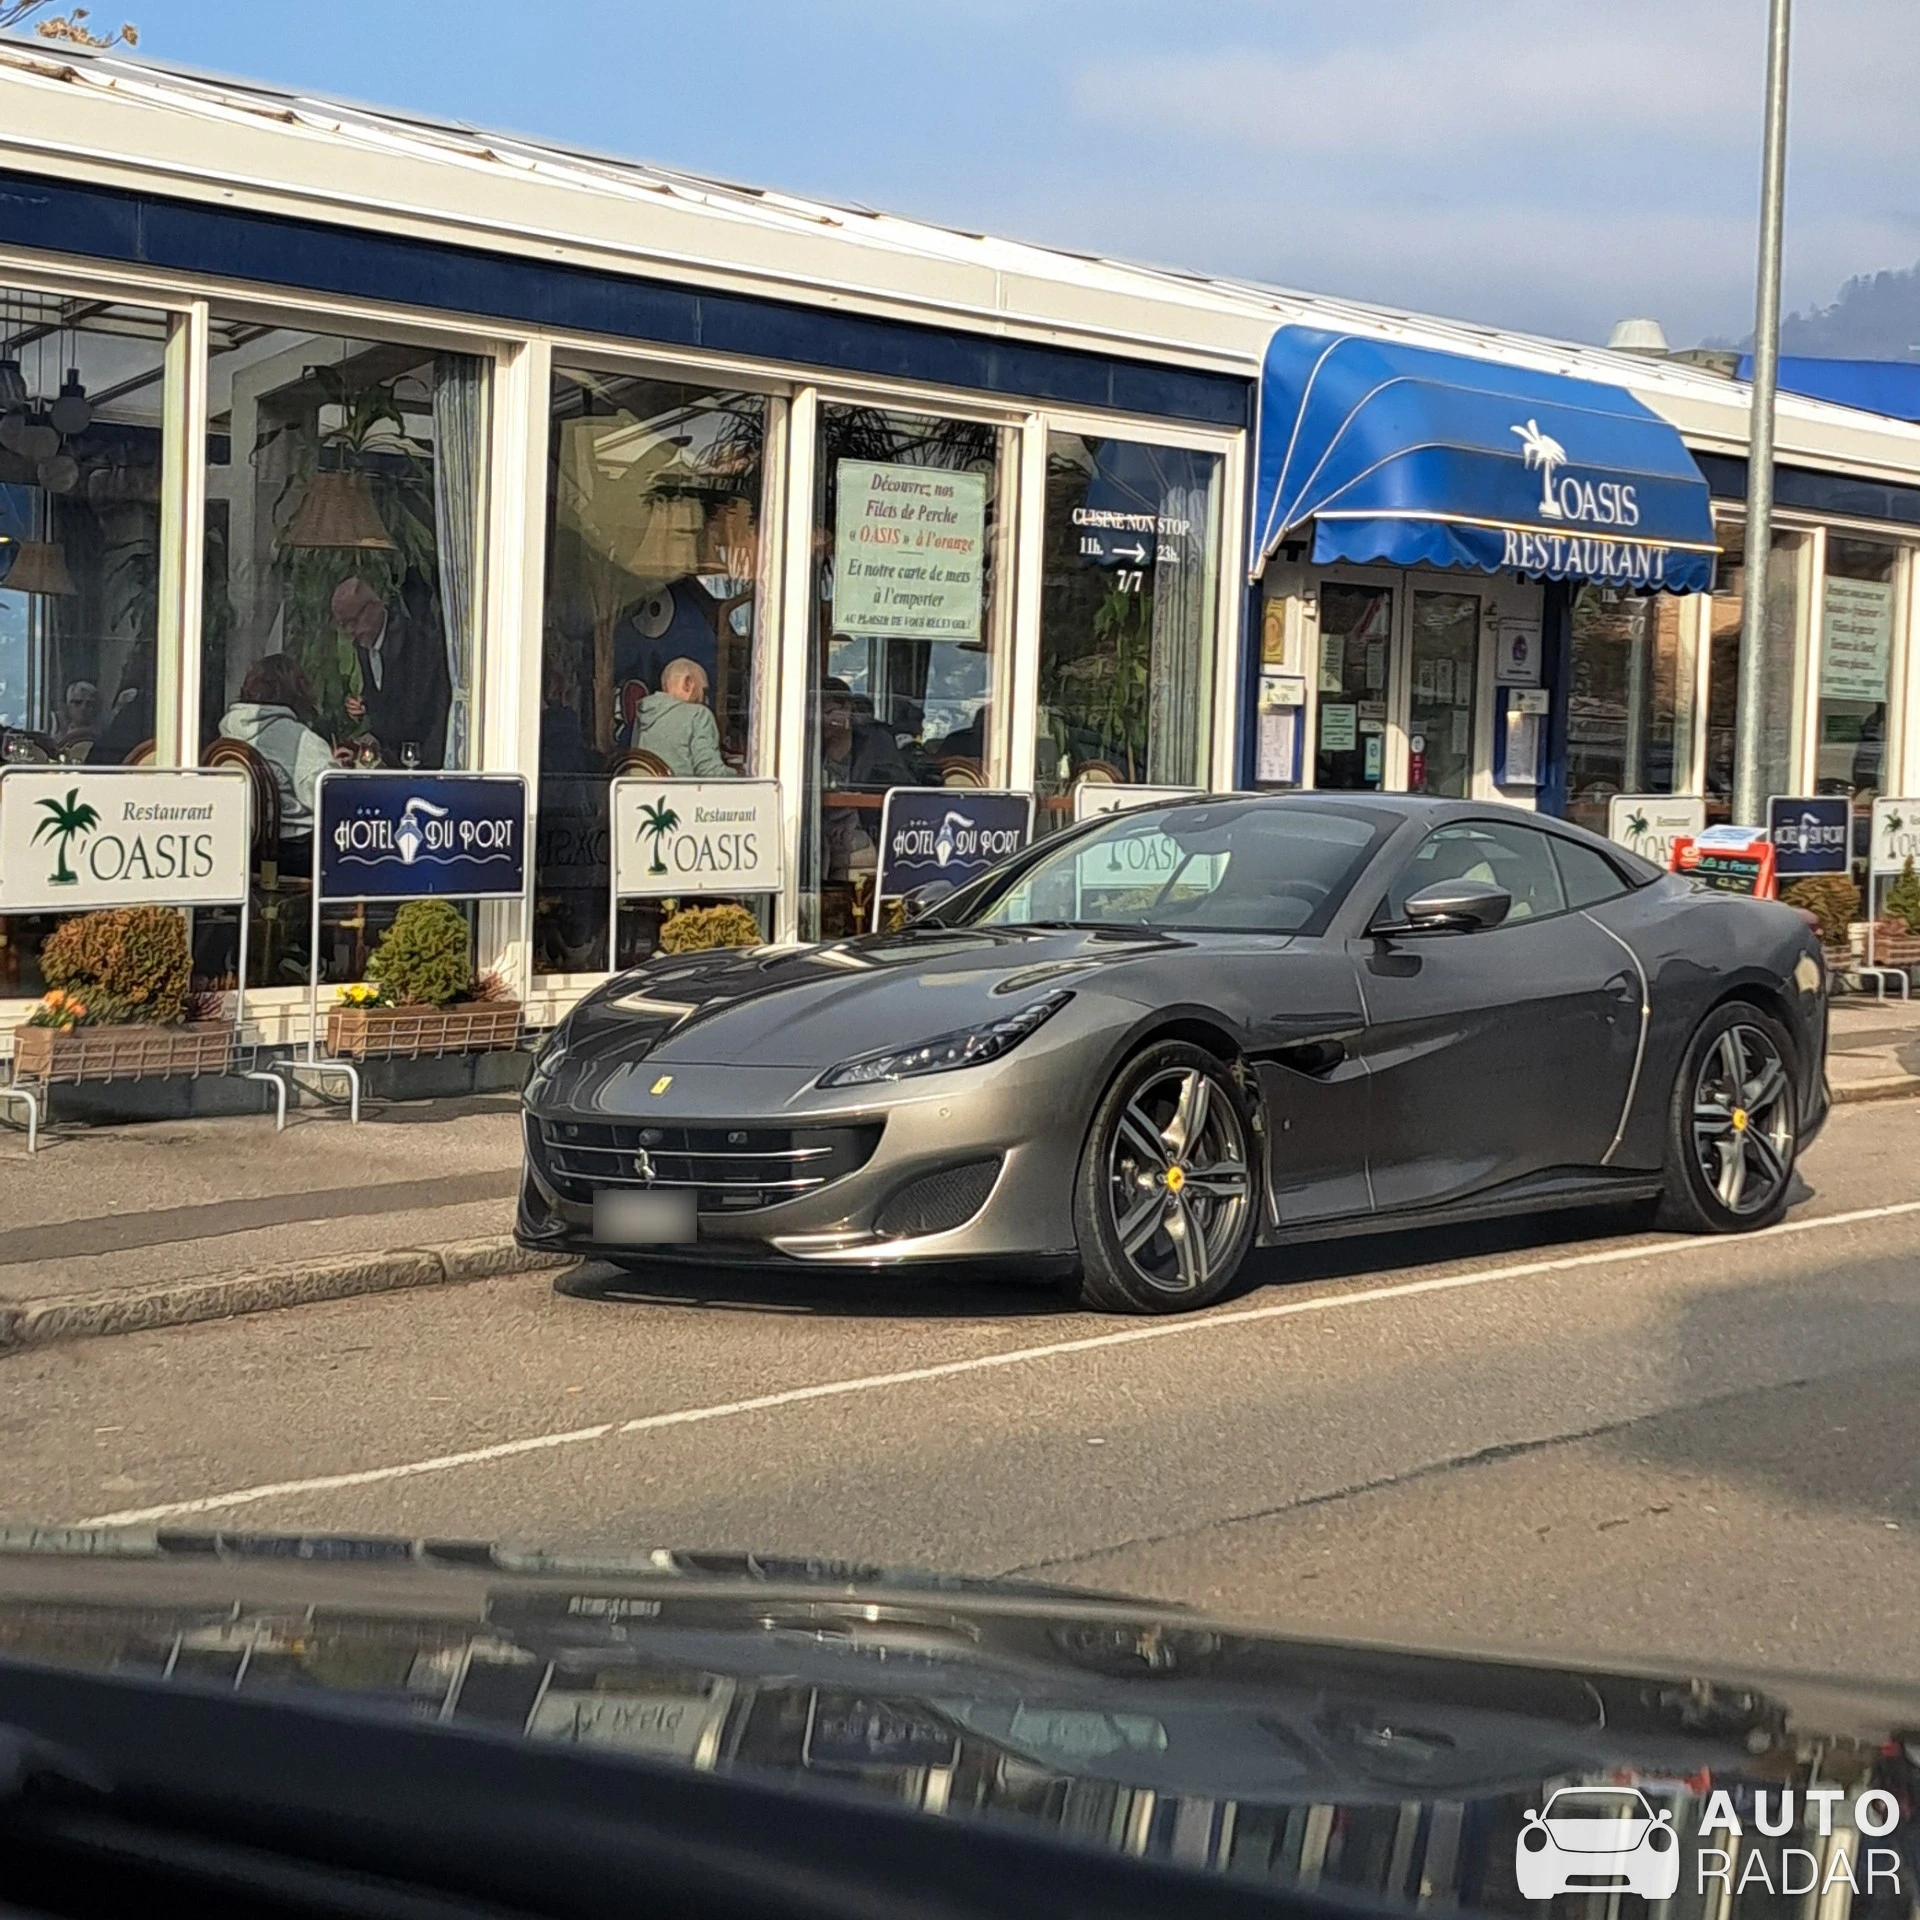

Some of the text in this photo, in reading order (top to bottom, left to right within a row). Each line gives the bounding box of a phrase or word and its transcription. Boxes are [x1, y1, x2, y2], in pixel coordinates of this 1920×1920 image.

[934, 484, 954, 498] nos
[866, 499, 958, 524] Filets de Perche
[860, 525, 901, 544] OASIS
[915, 530, 924, 547] à
[1157, 517, 1191, 536] STOP
[1501, 529, 1670, 580] RESTAURANT
[847, 558, 861, 576] Et
[864, 564, 896, 579] notre
[898, 566, 926, 580] carte
[929, 564, 943, 582] de
[1117, 569, 1143, 593] 7/7
[873, 586, 945, 610] à l'emporter
[122, 801, 213, 821] Restaurant
[695, 806, 757, 823] Restaurant
[334, 819, 395, 852] HOTEL
[425, 820, 453, 849] DU
[458, 819, 514, 850] PORT
[893, 830, 1020, 857] HOTEL DU PORT
